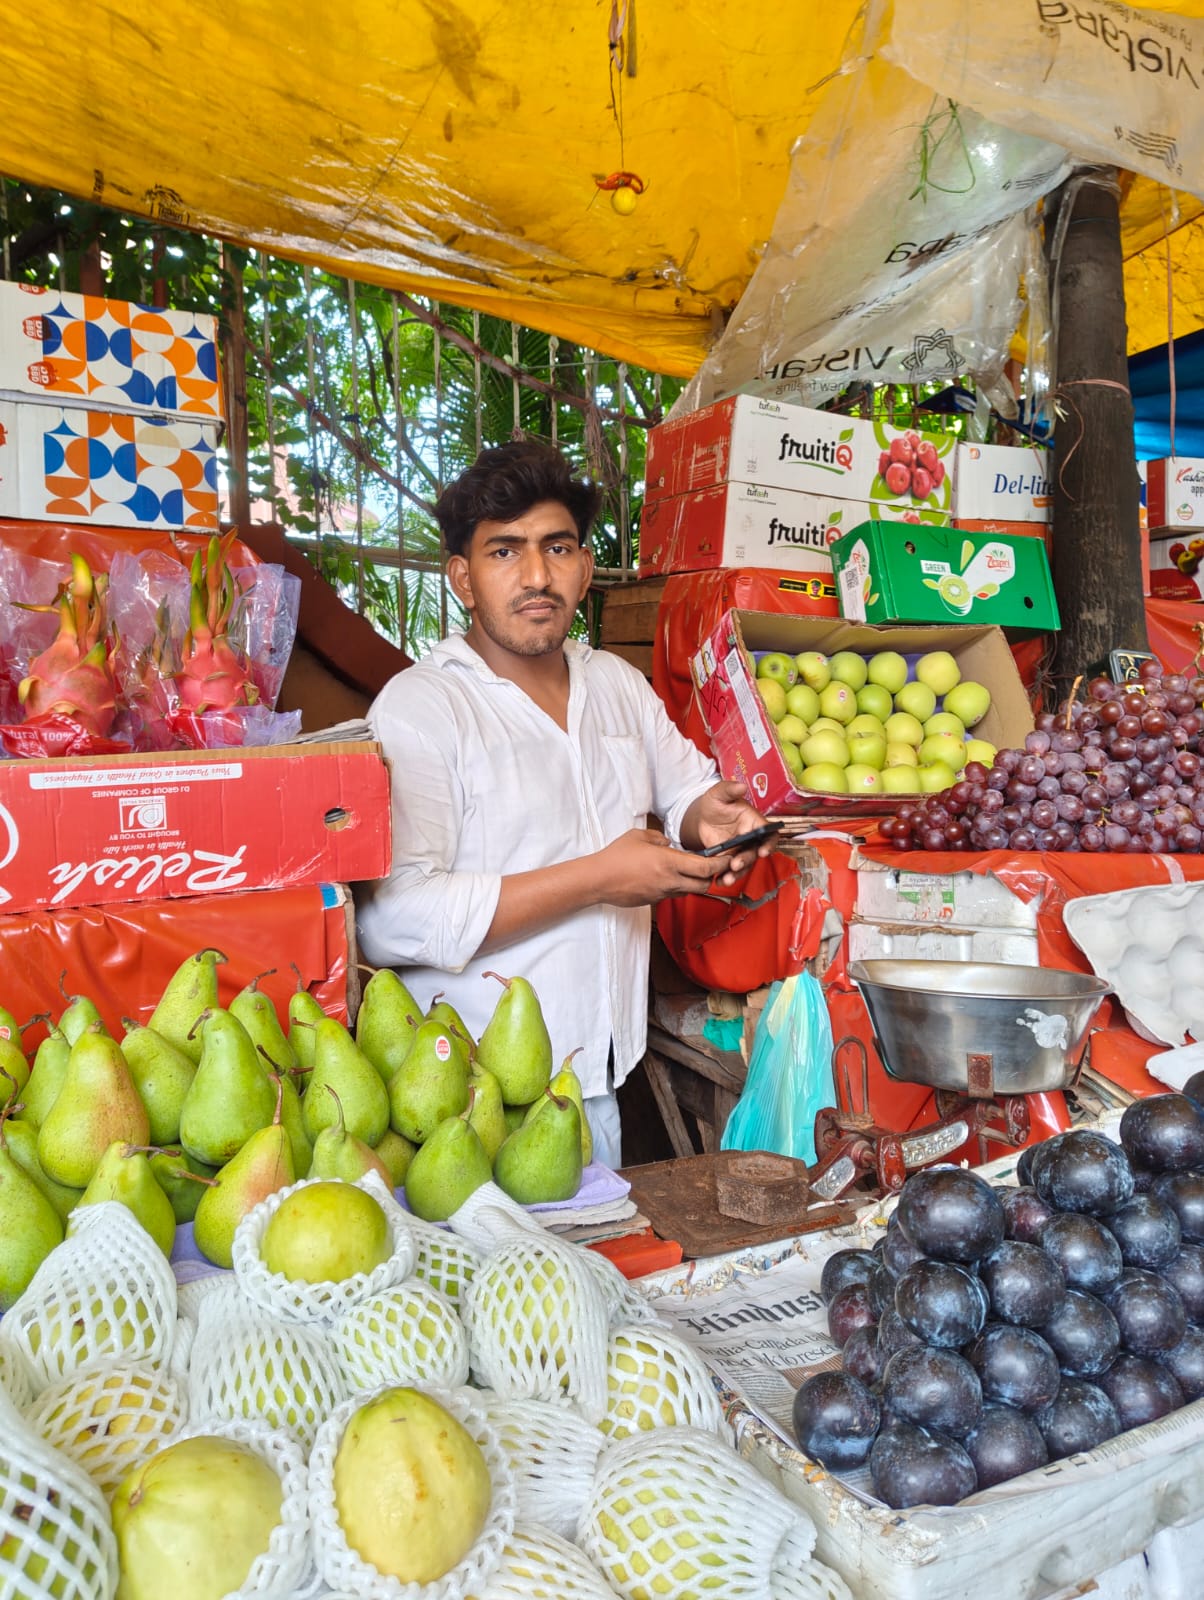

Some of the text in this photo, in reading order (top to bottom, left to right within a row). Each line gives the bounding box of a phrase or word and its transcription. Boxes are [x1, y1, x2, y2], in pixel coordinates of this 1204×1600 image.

[779, 433, 854, 471] fruitiQ
[993, 473, 1055, 496] Del-lite
[924, 562, 946, 573] GREEN
[42, 731, 75, 742] 100%
[44, 773, 94, 784] Happiness
[107, 772, 137, 781] Health
[139, 770, 163, 780] Good
[164, 770, 173, 778] in
[175, 768, 209, 778] Partner
[92, 788, 138, 798] COMPANIES
[152, 786, 180, 795] GROUP
[108, 830, 180, 841] BROUGHT TO YOU BY
[102, 840, 186, 855] Health in each bite
[48, 845, 247, 904] Relish
